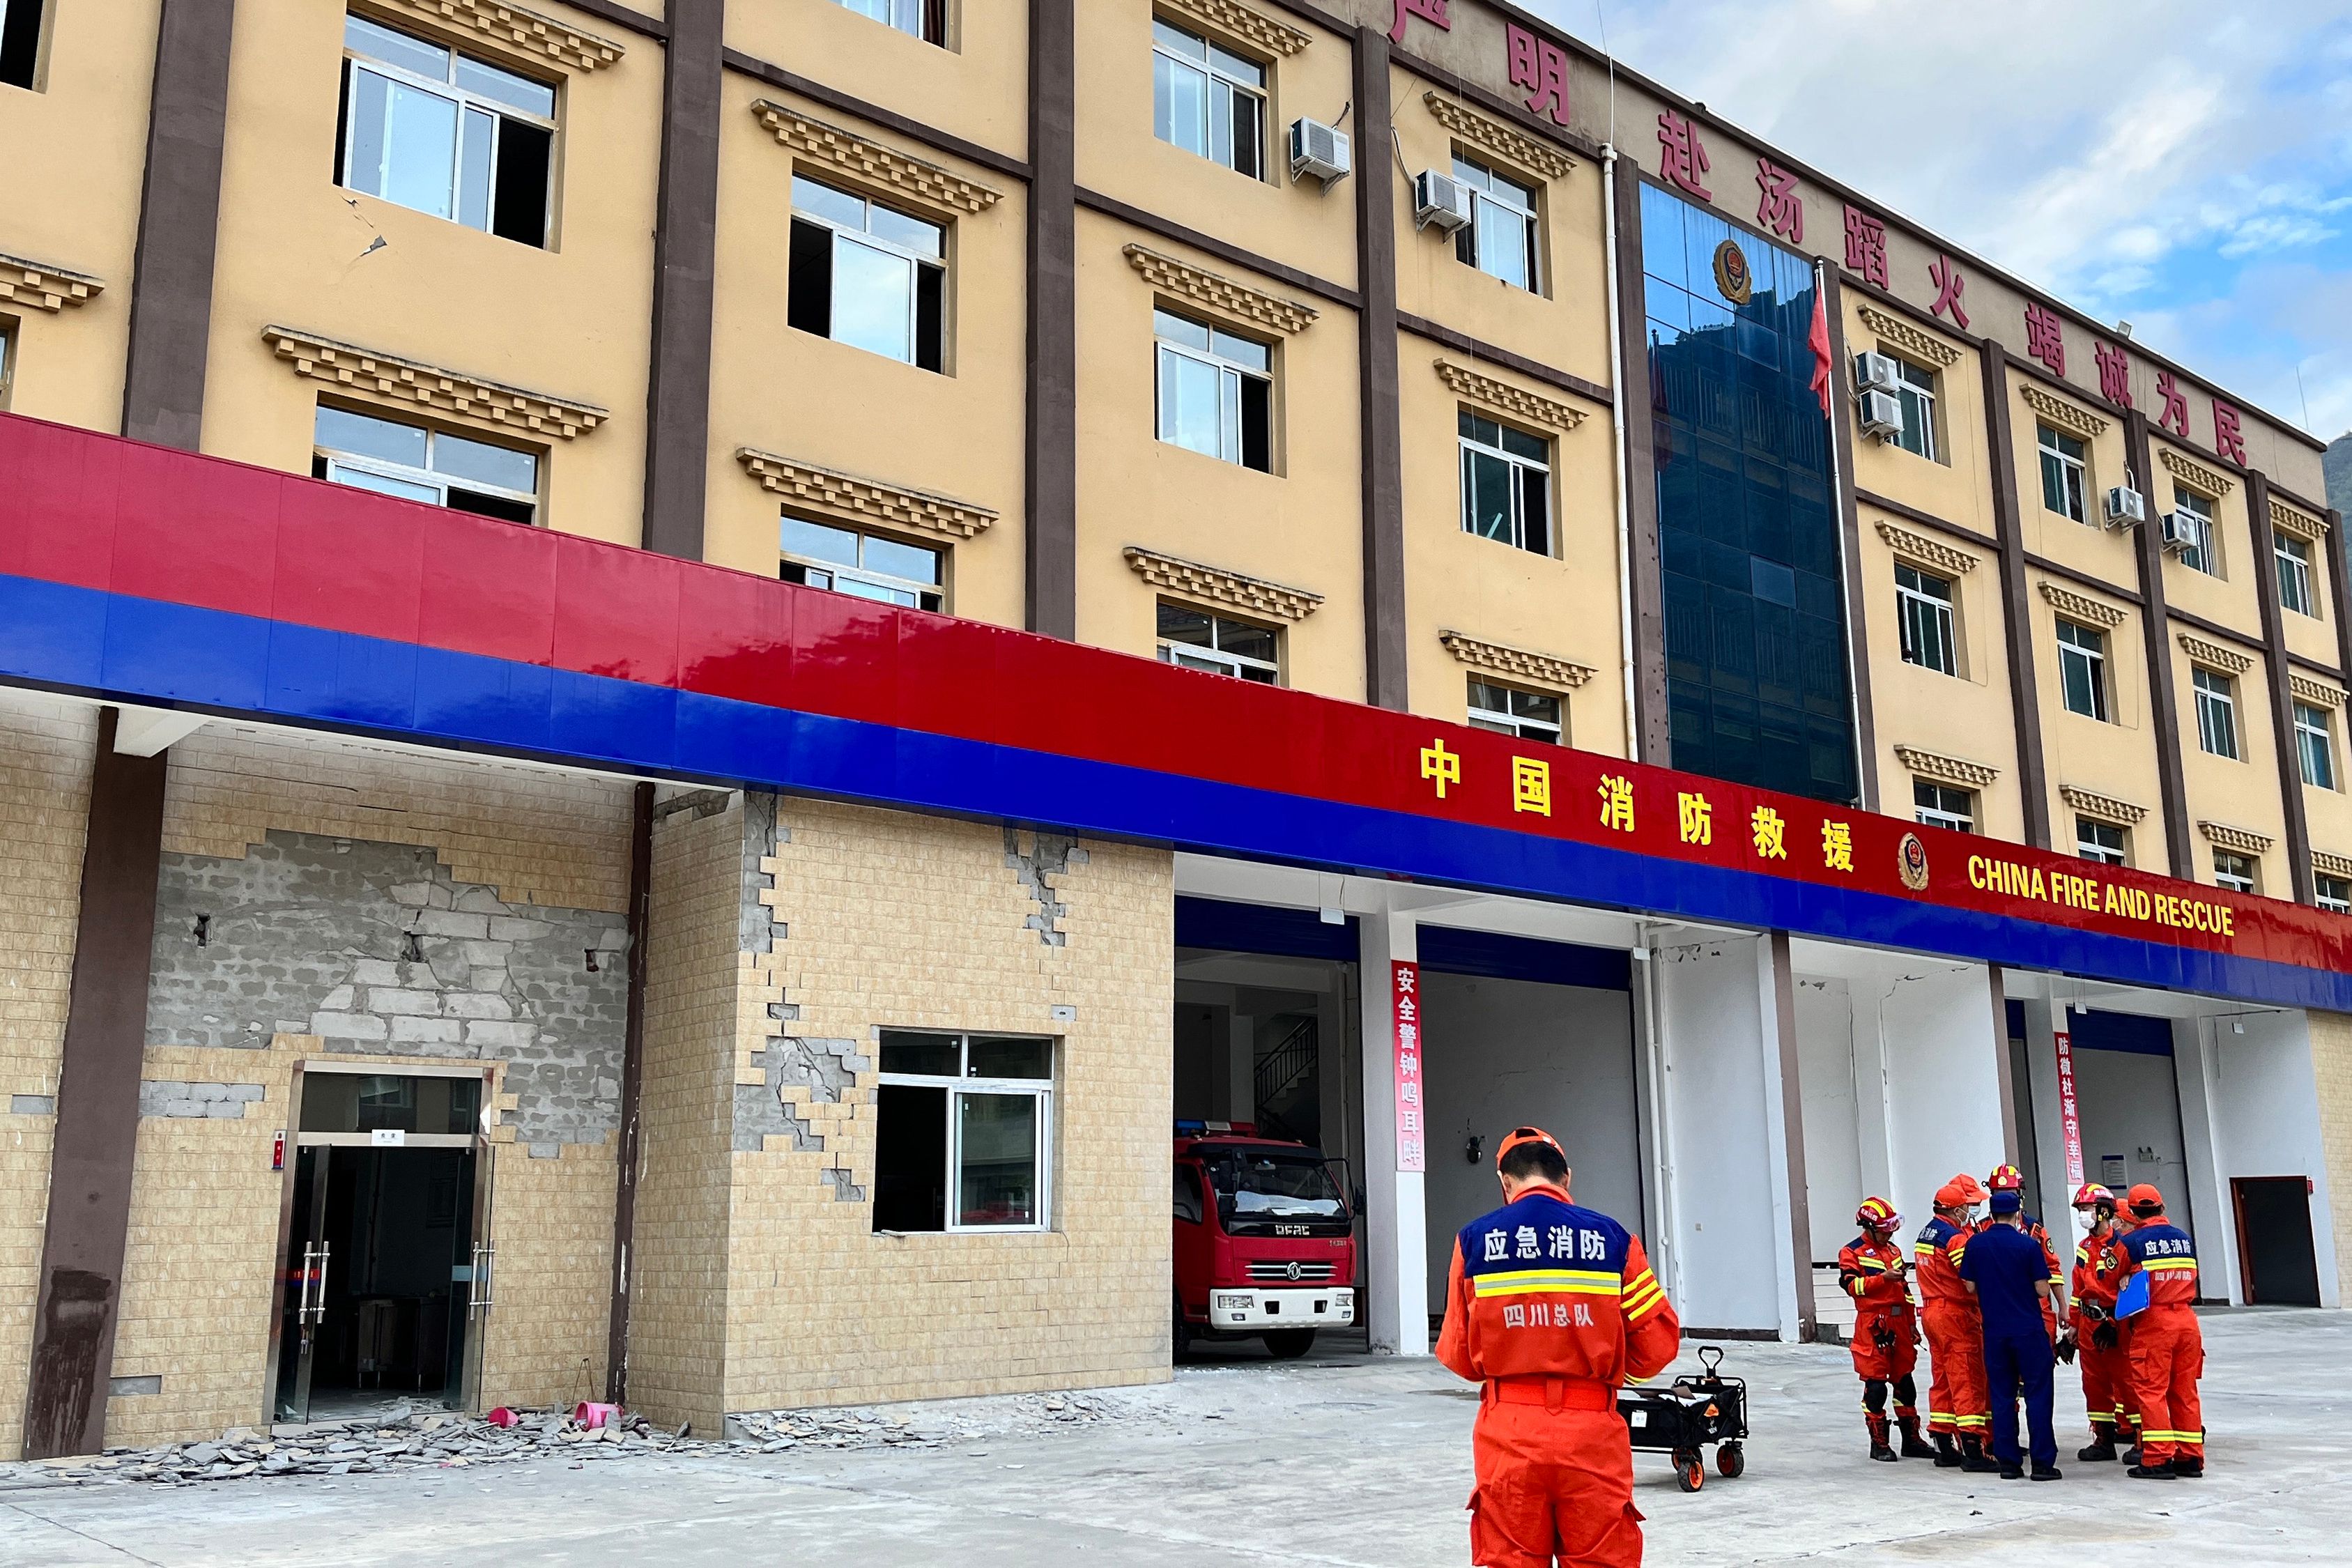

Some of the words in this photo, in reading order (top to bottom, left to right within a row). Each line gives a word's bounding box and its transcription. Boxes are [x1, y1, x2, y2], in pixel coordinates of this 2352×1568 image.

[1658, 109, 1969, 329] 赴汤蹈火
[2025, 302, 2247, 467] 竭诚为民
[1420, 739, 1854, 873] 中国消防救援
[1968, 855, 2047, 902] CHINA
[2050, 872, 2100, 912] FIRE
[2105, 884, 2151, 921] AND
[2154, 893, 2235, 937] RESCUE
[1397, 967, 1420, 1165] 安全警钟鸣耳畔
[2058, 1037, 2082, 1180] 防微杜渐守幸福
[1275, 1224, 1310, 1236] DFAC
[1484, 1224, 1606, 1262] 应急消防
[2145, 1238, 2191, 1256] 应急消防
[1502, 1302, 1594, 1328] 四川总队
